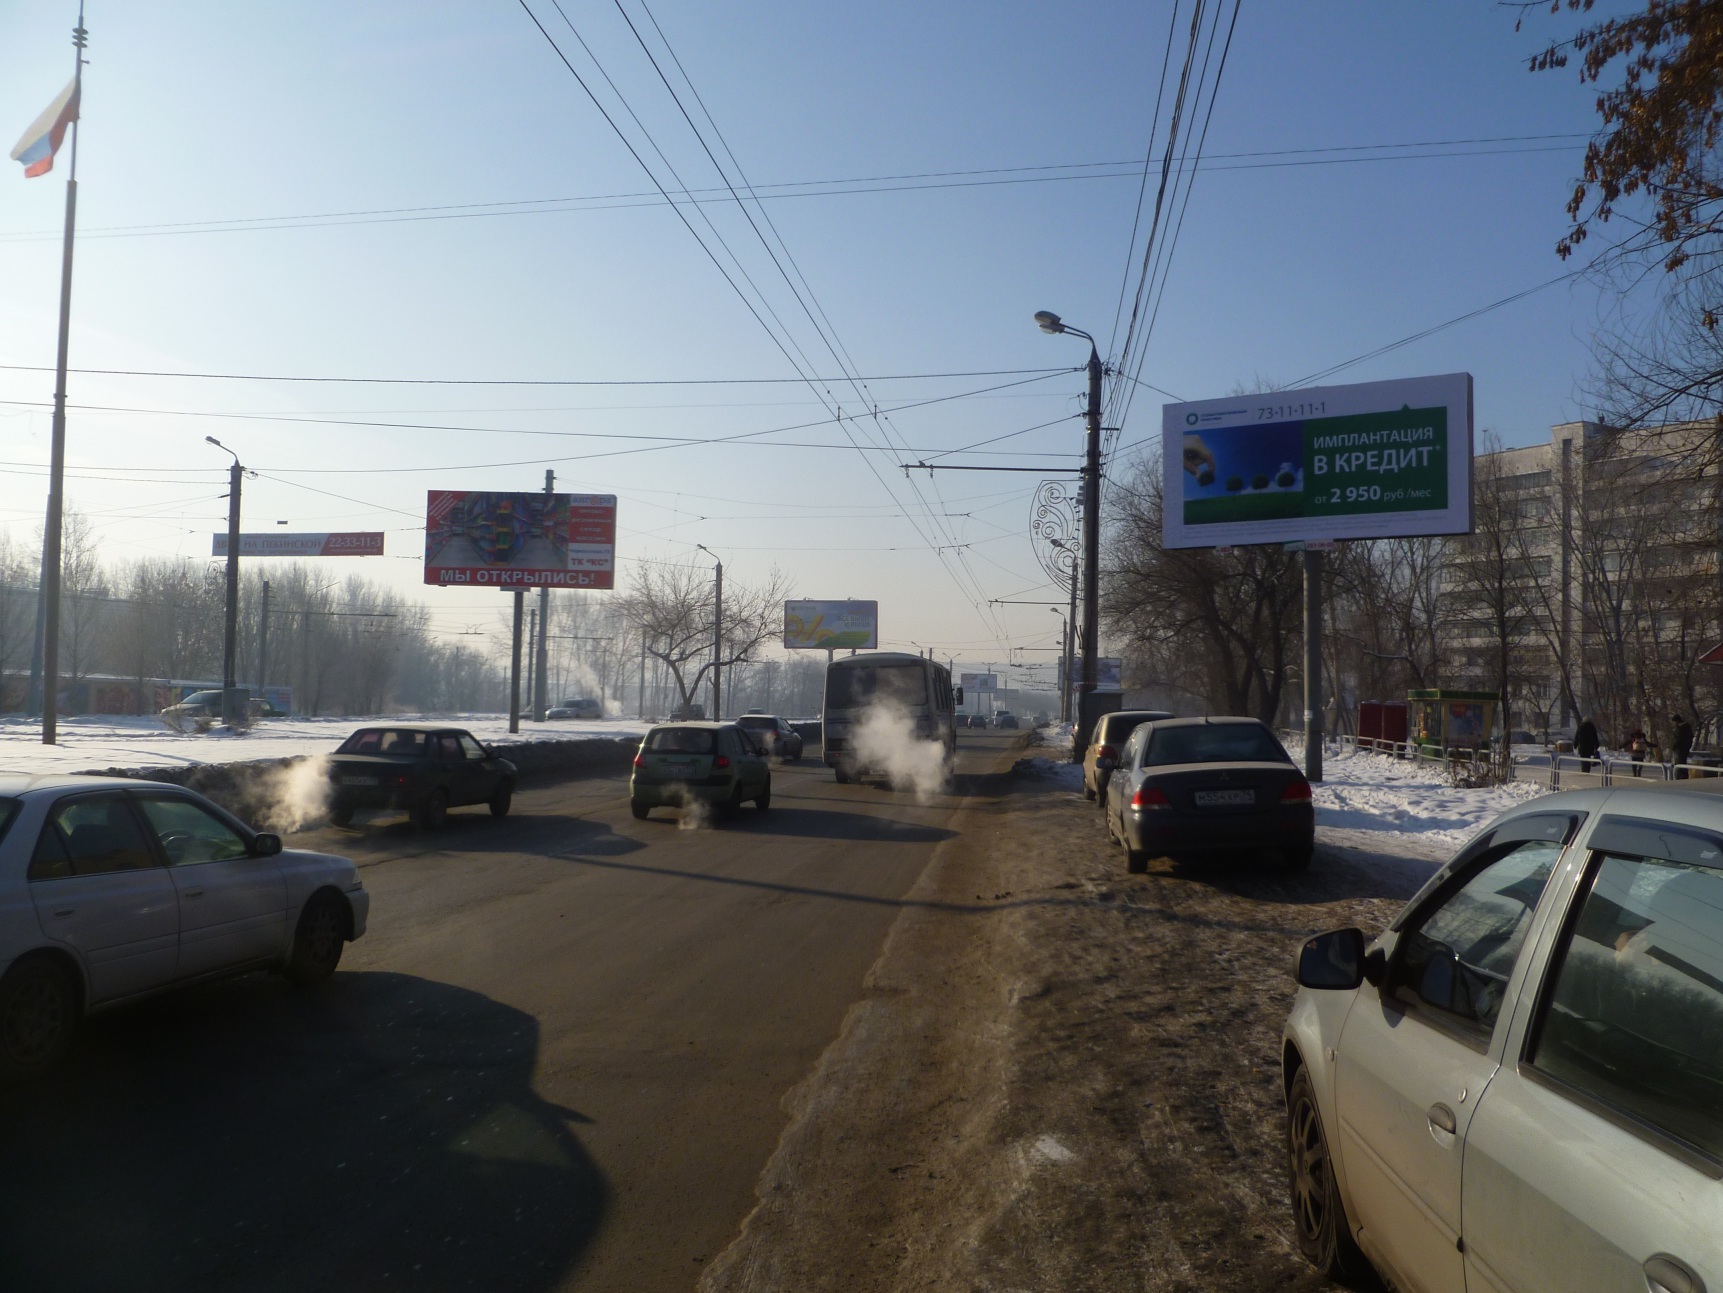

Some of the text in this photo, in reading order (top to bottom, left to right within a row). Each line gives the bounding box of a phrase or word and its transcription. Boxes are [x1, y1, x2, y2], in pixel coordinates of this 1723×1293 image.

[1313, 426, 1433, 449] ИМПЛАНТАЦИЯ
[1313, 455, 1328, 475] В
[1314, 494, 1327, 505] от
[262, 538, 321, 549] ПЕКИНСКОЙ
[328, 536, 382, 548] 22-33-11-3
[571, 558, 584, 566] ТК
[440, 569, 595, 585] МЫ ОТКРЫЛИСЬ!
